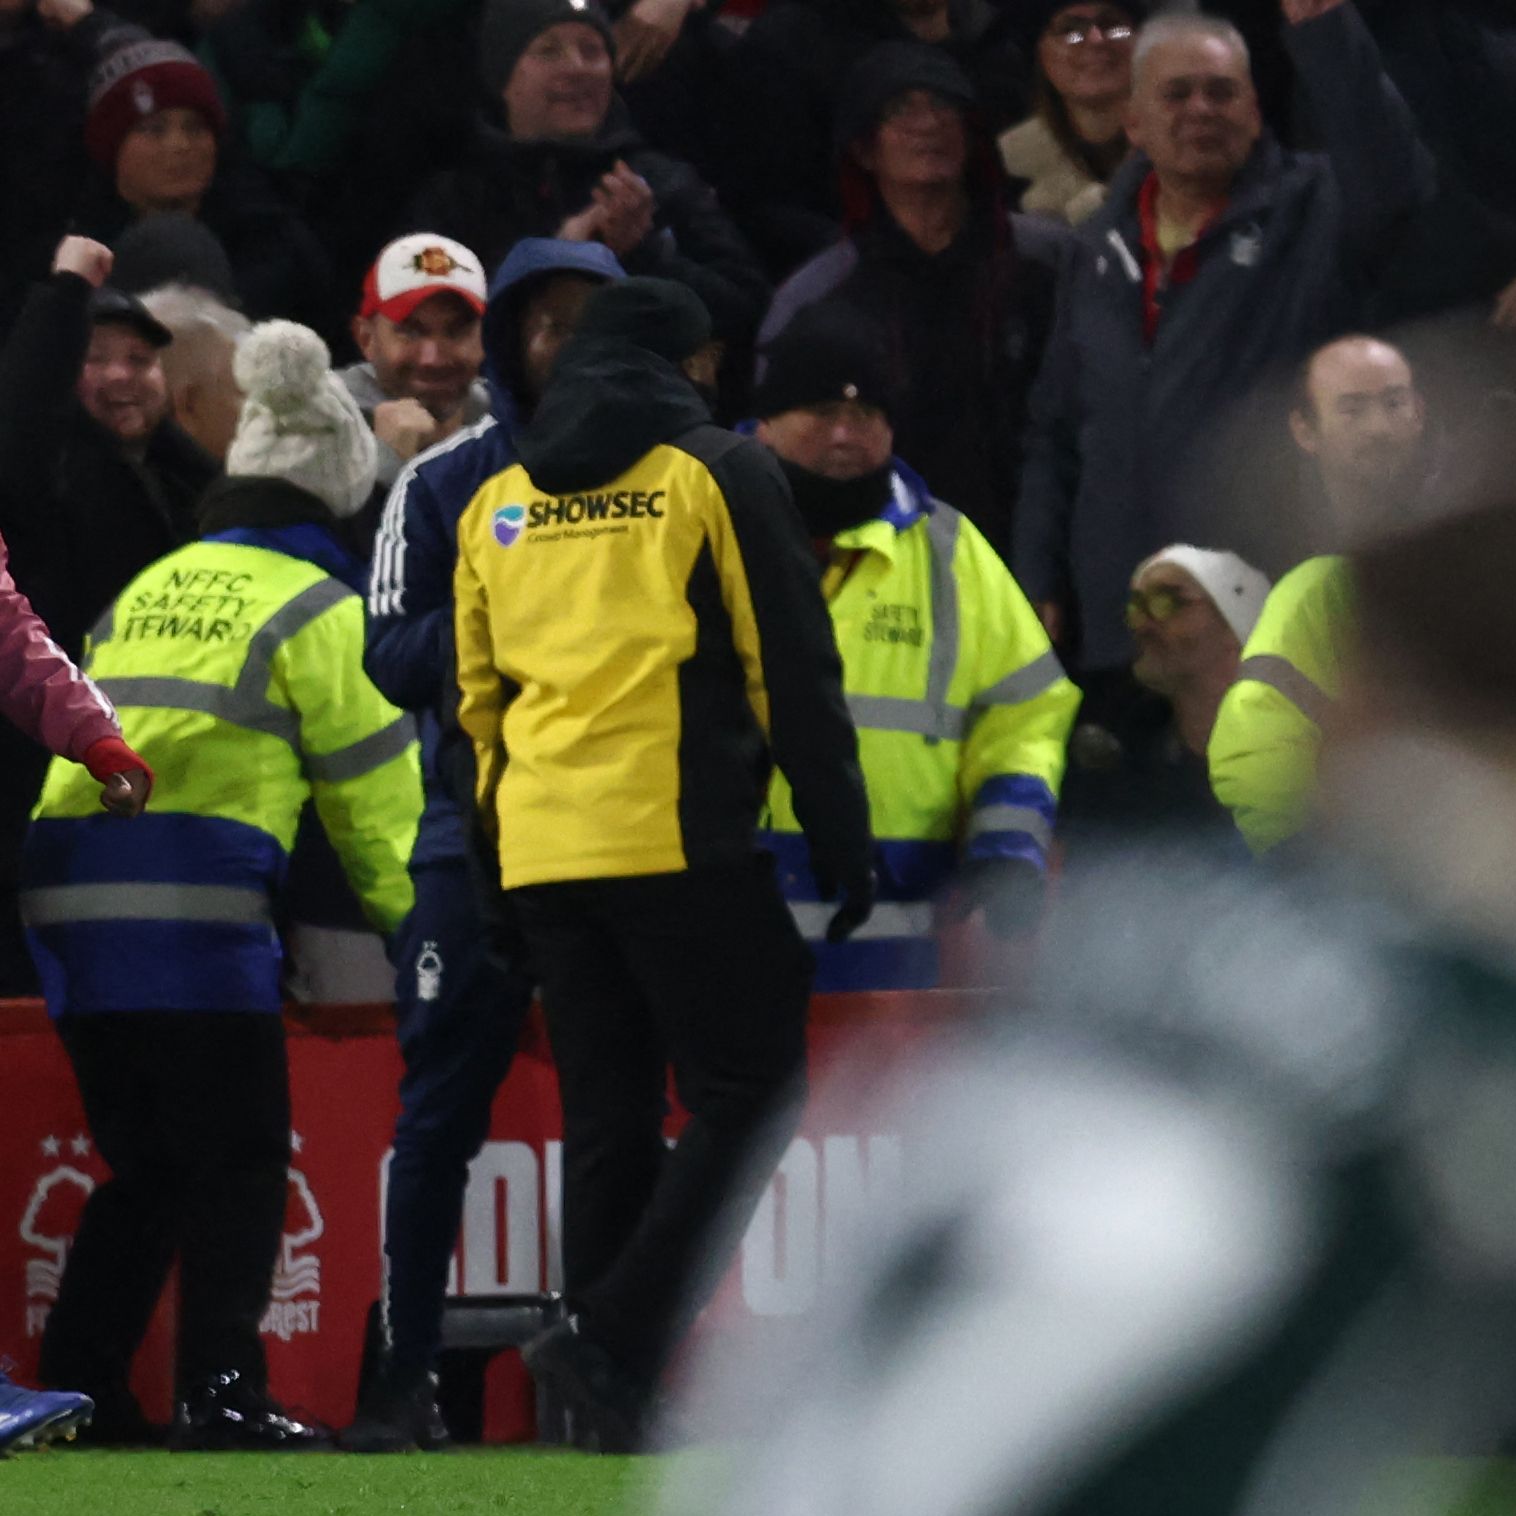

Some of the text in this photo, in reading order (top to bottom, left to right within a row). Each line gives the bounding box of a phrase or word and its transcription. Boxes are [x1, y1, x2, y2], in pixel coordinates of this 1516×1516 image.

[527, 490, 666, 528] SHOWSEC
[164, 568, 253, 592] NFFC
[130, 592, 257, 618] SAFETY
[124, 615, 251, 642] TEWARD
